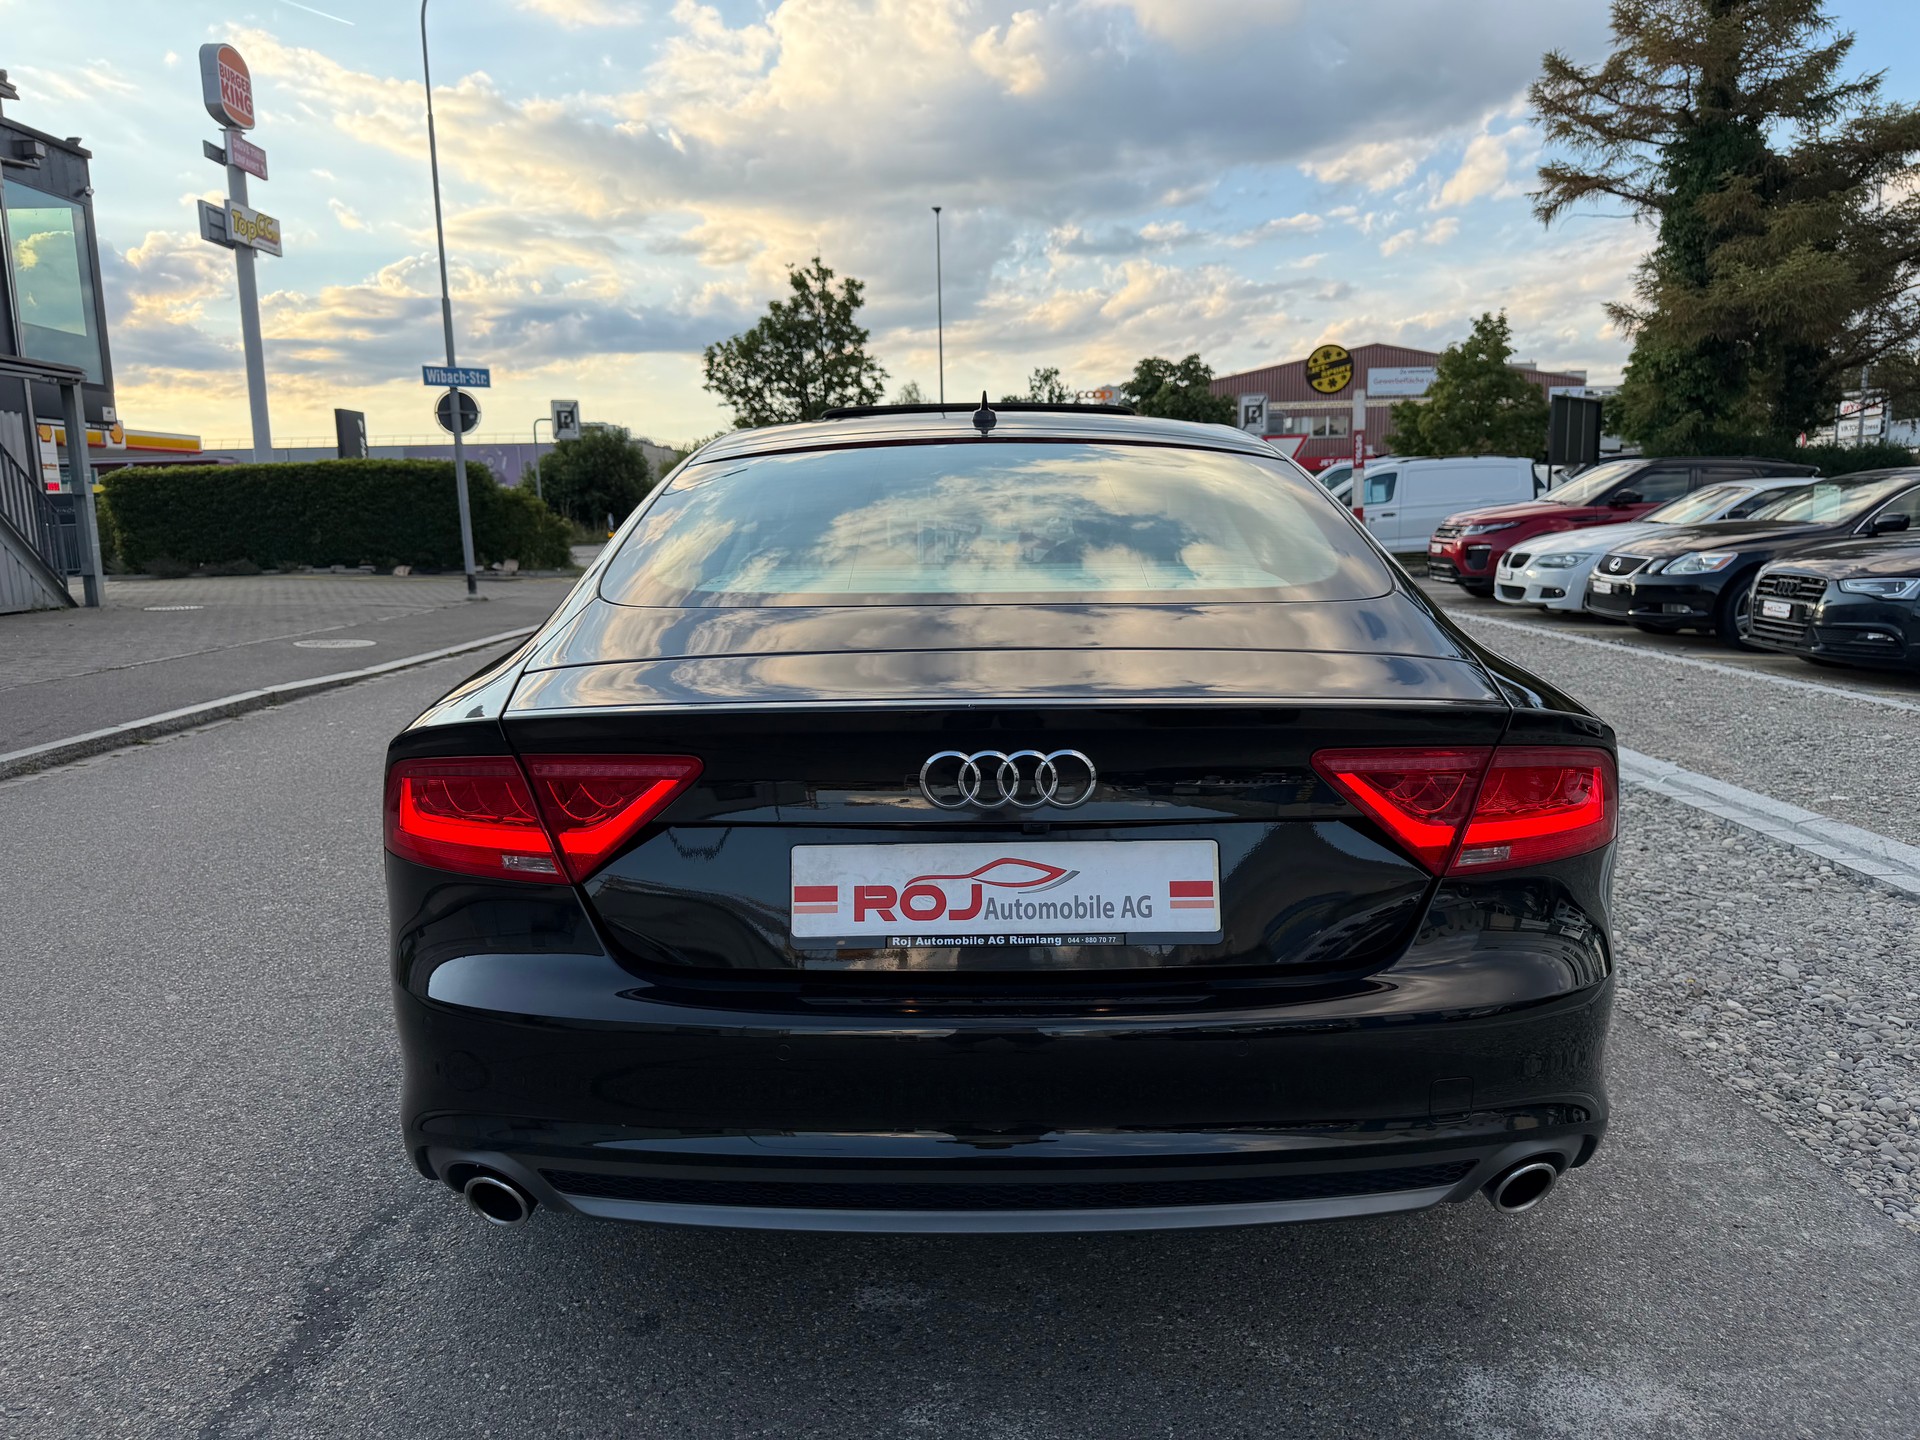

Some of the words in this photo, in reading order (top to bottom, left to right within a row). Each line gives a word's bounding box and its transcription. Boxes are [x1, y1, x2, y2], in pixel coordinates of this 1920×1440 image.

[219, 63, 251, 94] BURGER
[221, 79, 253, 116] KING
[231, 208, 274, 245] TopCC
[425, 368, 488, 385] Wibach-Str.
[854, 884, 982, 922] ROJ
[984, 895, 1115, 921] Automobile
[1121, 895, 1153, 919] AG
[892, 937, 911, 947] Roj
[915, 936, 985, 946] Automobile
[988, 936, 1005, 945] AG
[1009, 935, 1062, 945] Rümlang
